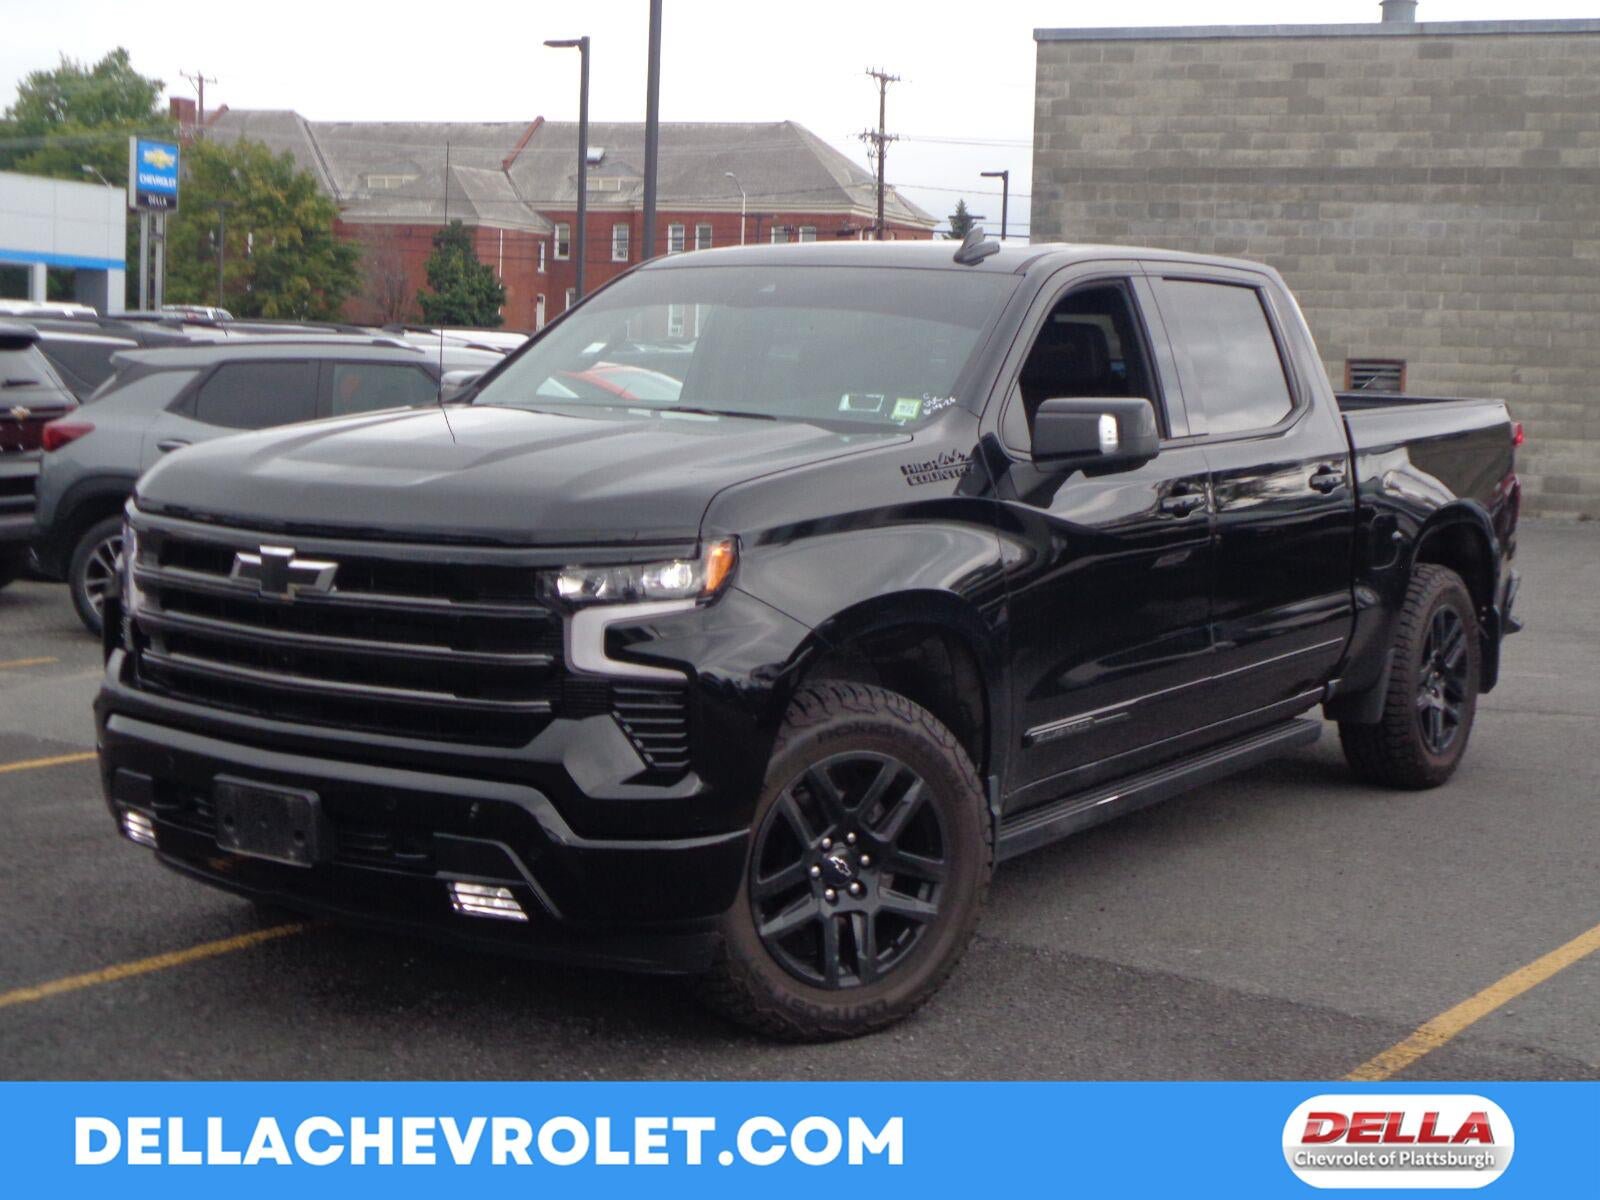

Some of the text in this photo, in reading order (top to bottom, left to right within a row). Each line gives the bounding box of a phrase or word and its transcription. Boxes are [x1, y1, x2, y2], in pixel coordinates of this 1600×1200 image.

[139, 174, 176, 187] CHEVROLET
[148, 194, 167, 207] DELLA
[901, 461, 938, 475] HIGH
[907, 465, 970, 485] COUNTRY
